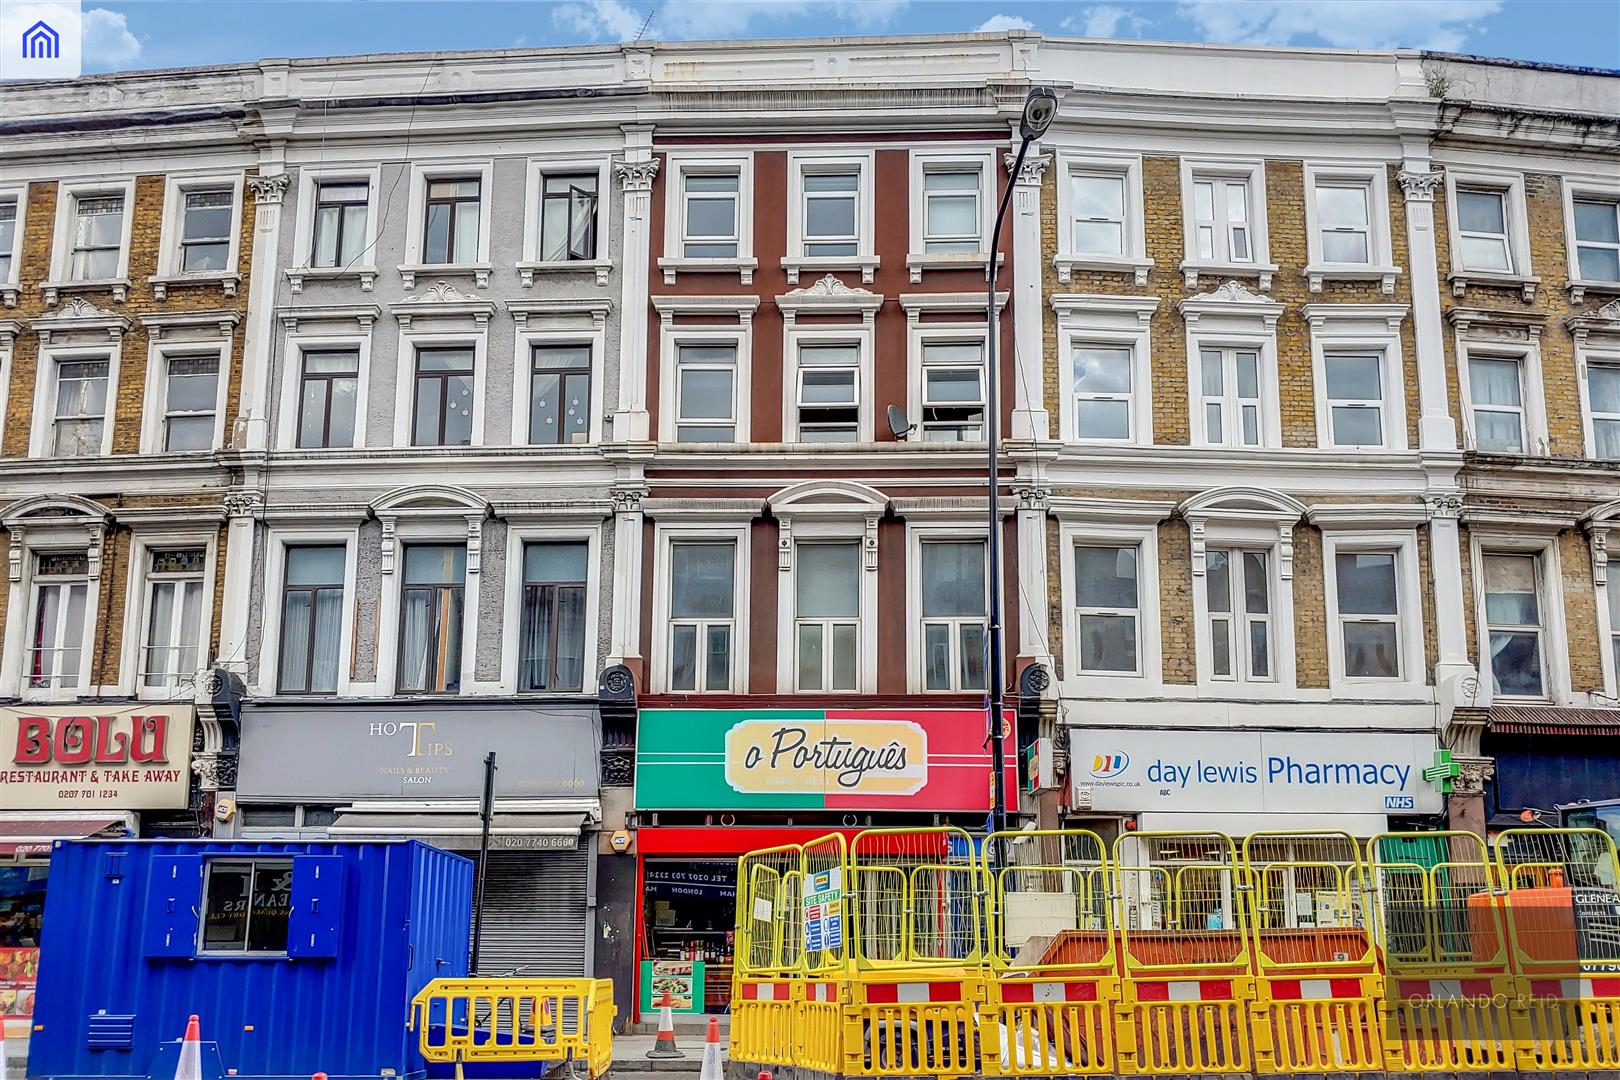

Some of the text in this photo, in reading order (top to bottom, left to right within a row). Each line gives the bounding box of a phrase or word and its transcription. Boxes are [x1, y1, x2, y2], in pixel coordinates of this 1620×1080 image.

[12, 715, 171, 766] BOLU
[745, 727, 906, 787] o Português
[0, 770, 181, 784] RESTAURANT & TAKE AWAY
[402, 776, 432, 784] SALON
[1147, 756, 1411, 791] day lewis Pharmacy
[58, 790, 118, 799] 0207 701 1234
[1386, 797, 1413, 809] NHS
[505, 838, 522, 847] 020
[526, 838, 549, 847] 7740
[805, 896, 817, 907] SITE
[817, 889, 839, 904] SAFETY
